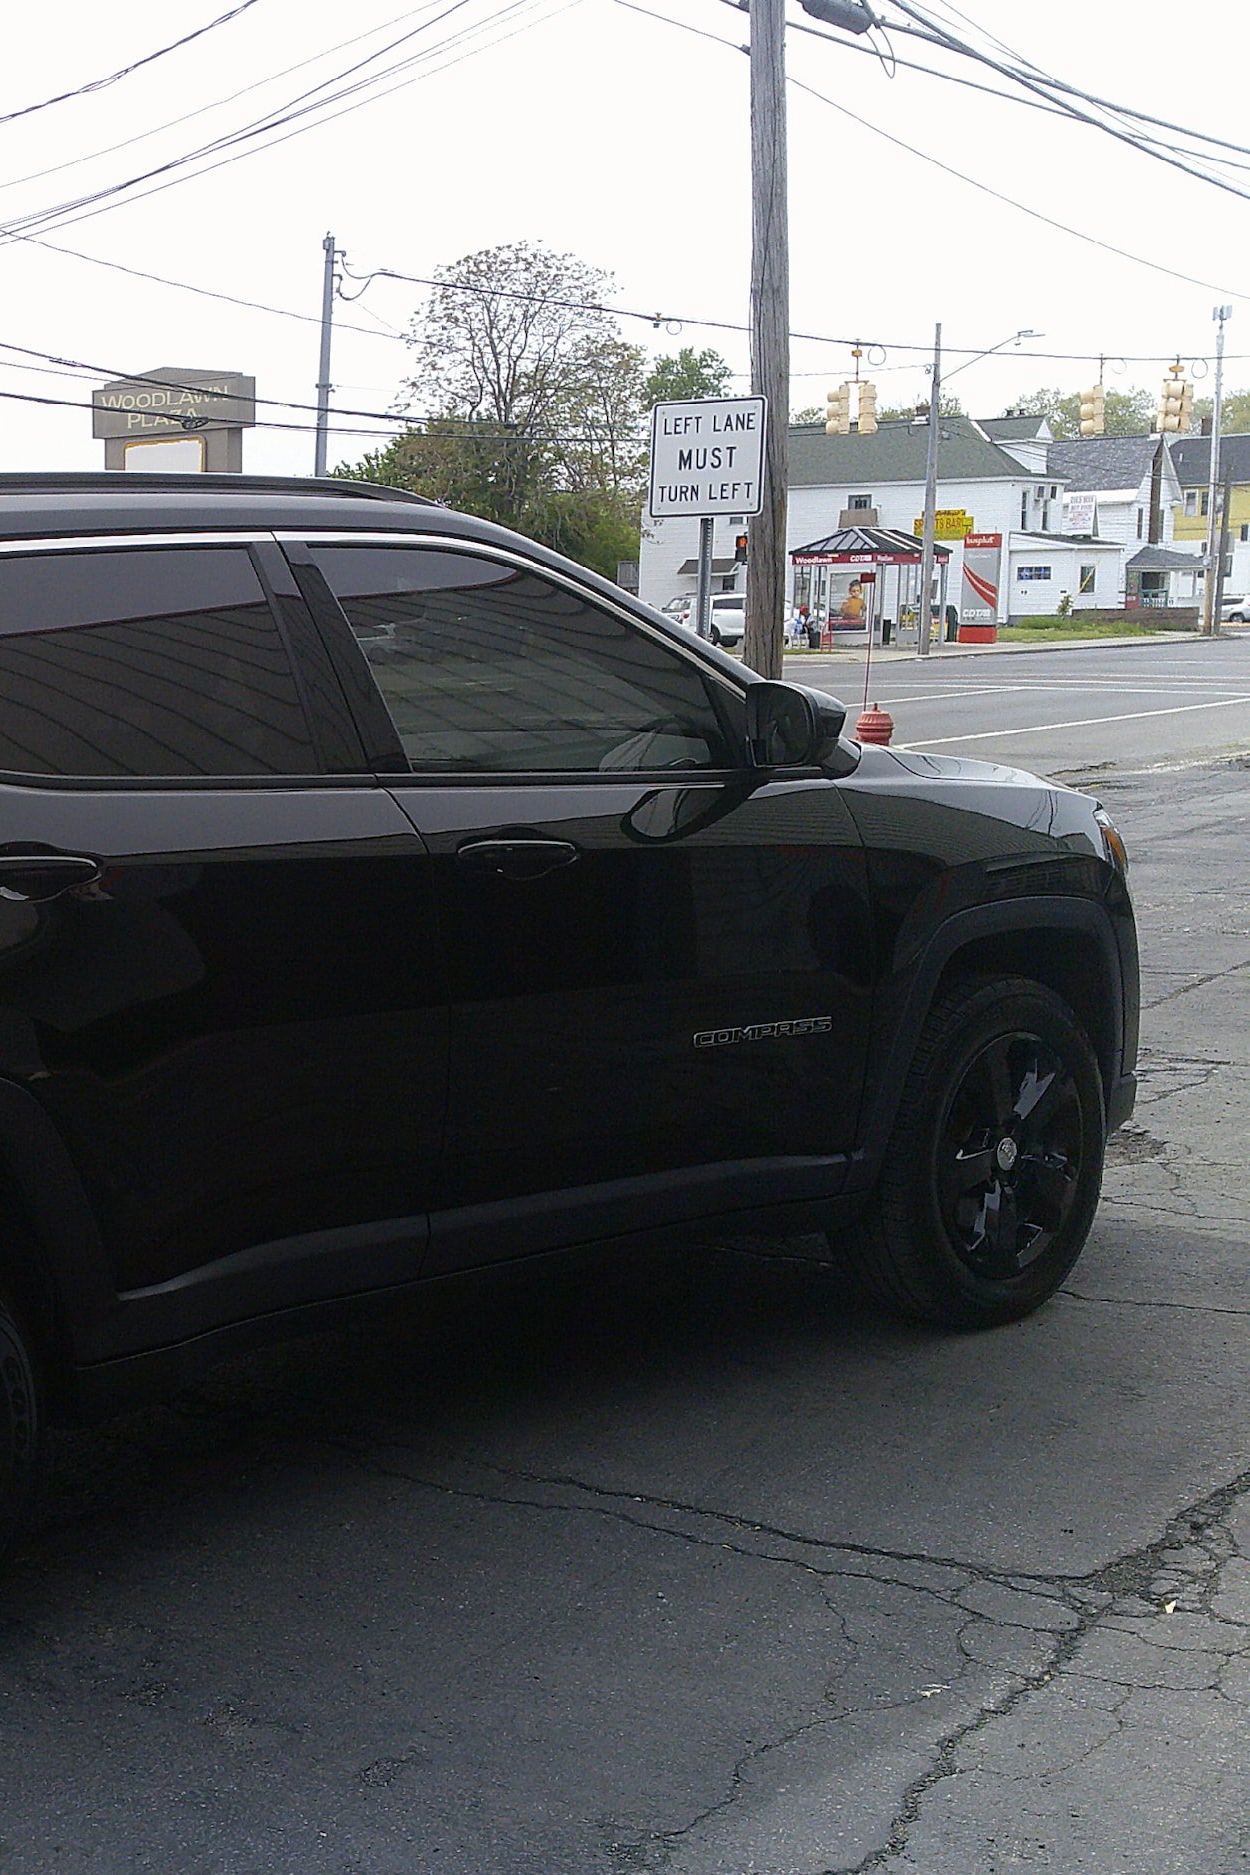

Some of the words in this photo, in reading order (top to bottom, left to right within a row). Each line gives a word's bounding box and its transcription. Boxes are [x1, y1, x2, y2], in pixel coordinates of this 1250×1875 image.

[663, 416, 702, 436] LEFT
[713, 412, 756, 432] LANE
[678, 446, 737, 471] MUST
[658, 484, 700, 503] TURN
[708, 482, 753, 500] LEFT
[795, 556, 833, 564] Woodlawn
[693, 1015, 833, 1048] COMPASS
